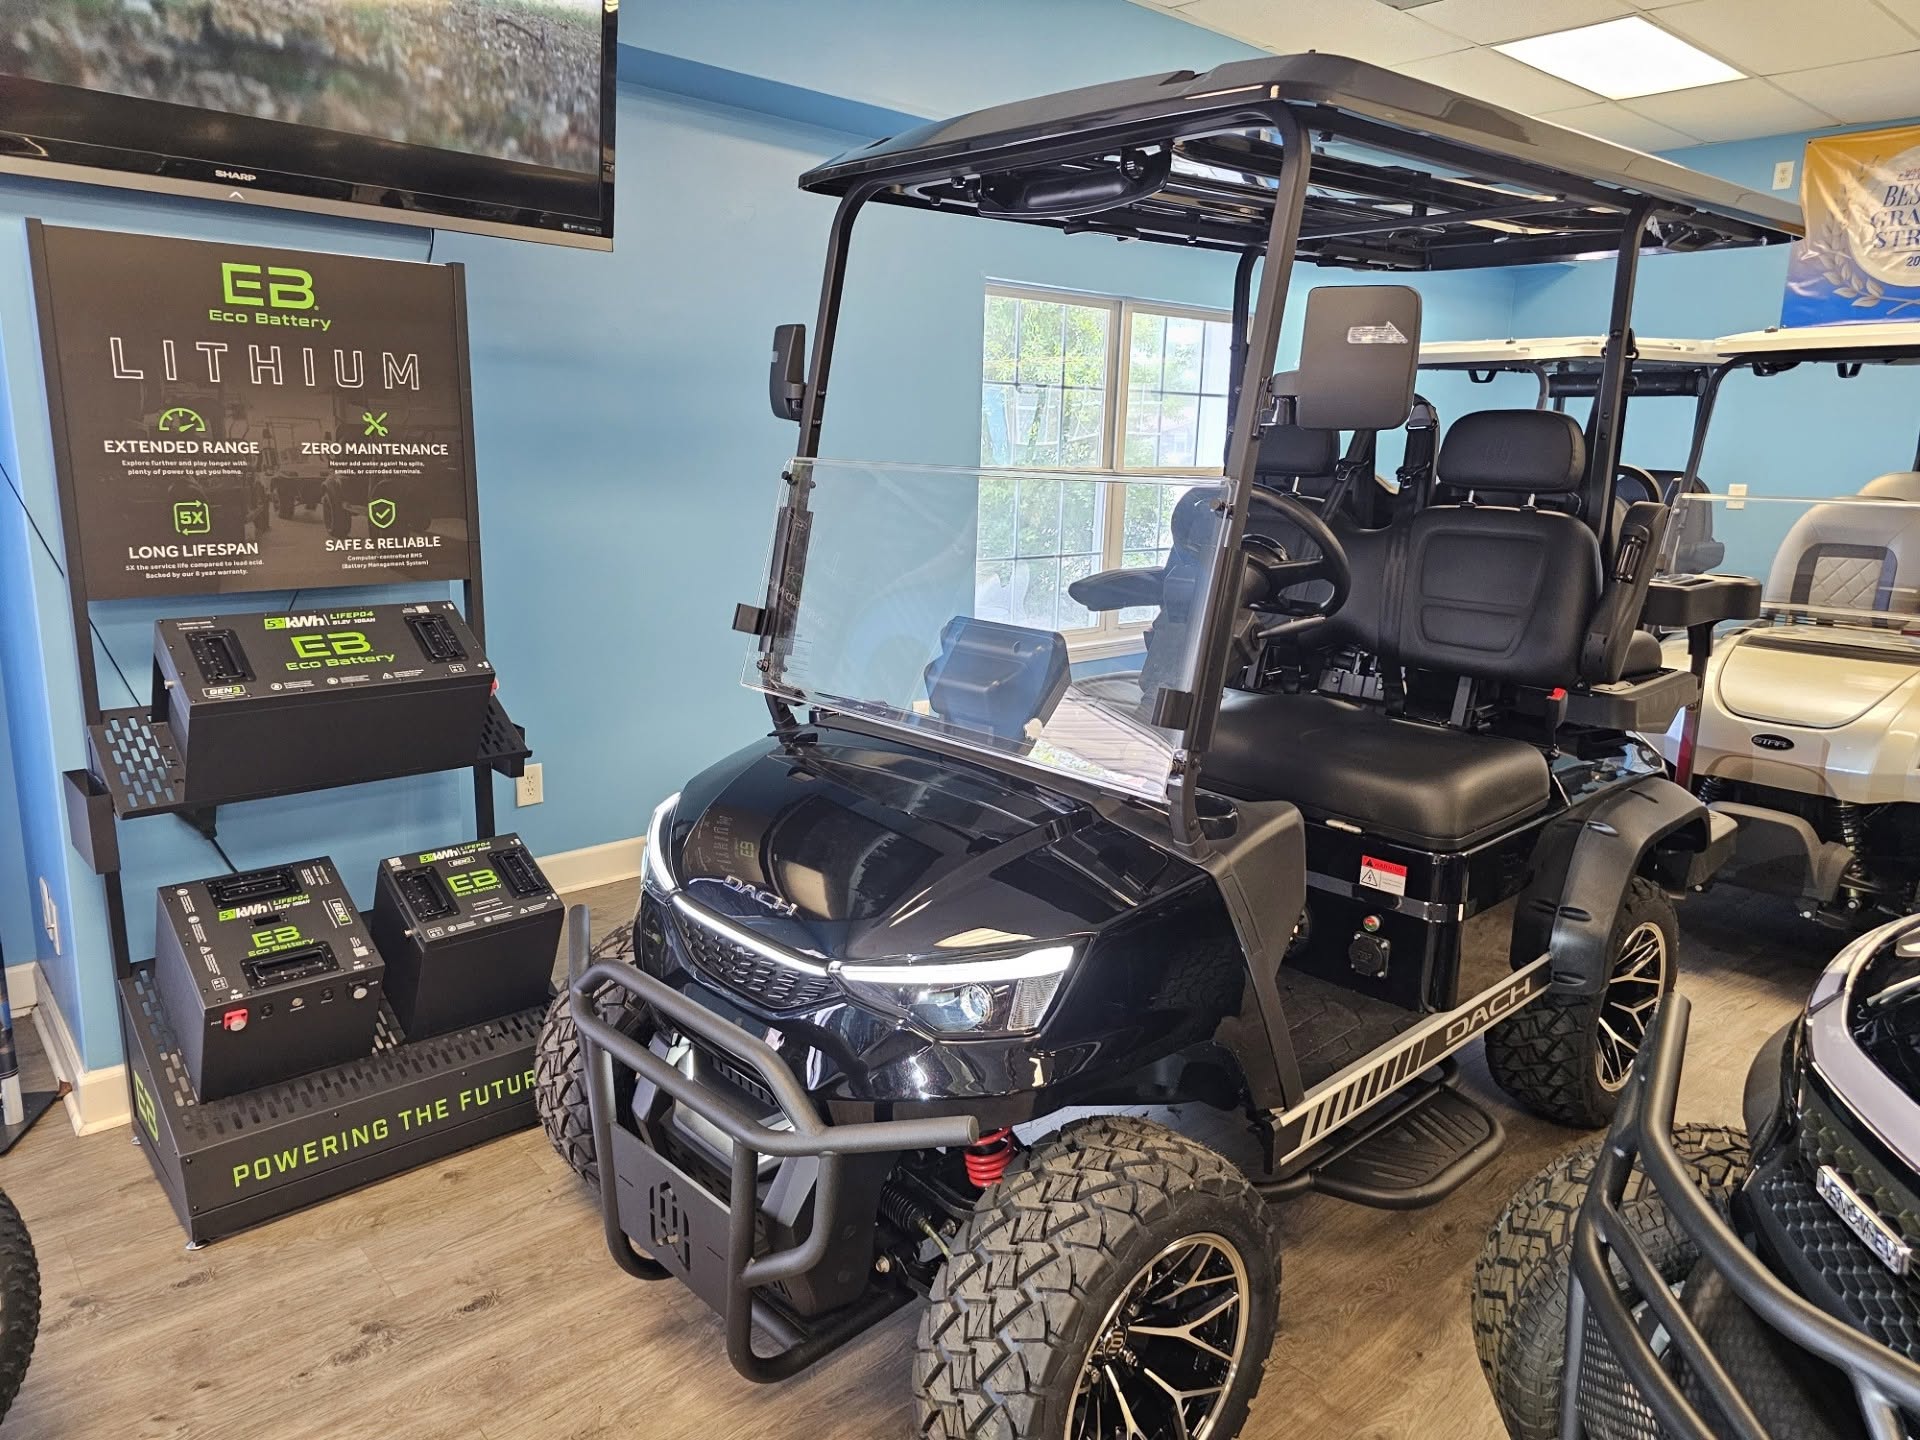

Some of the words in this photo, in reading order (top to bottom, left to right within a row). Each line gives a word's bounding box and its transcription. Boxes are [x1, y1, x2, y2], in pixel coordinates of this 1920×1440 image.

[215, 169, 256, 181] SHARP
[1883, 182, 1920, 207] BES
[1870, 208, 1920, 229] GRA
[1873, 229, 1920, 248] STR
[1906, 255, 1920, 267] 20
[222, 262, 315, 310] EB
[208, 309, 248, 323] Eco
[255, 312, 331, 332] Battery
[109, 337, 420, 390] LITHIUM
[103, 440, 199, 454] EXTENDED
[202, 441, 260, 454] RANGE
[301, 442, 342, 455] ZERO
[345, 443, 449, 456] MAINTENANCE
[179, 511, 204, 525] 5X
[128, 545, 179, 559] LONG
[182, 542, 259, 557] LIFESPAN
[325, 539, 362, 552] SAFE
[364, 538, 375, 550] &
[377, 536, 441, 549] RELIABLE
[150, 563, 176, 571] service
[190, 560, 224, 569] compared
[347, 553, 409, 561] Computer-controlled
[367, 560, 405, 568] Management
[145, 571, 171, 579] Backed
[171, 571, 181, 579] by
[201, 570, 216, 578] year
[291, 631, 371, 658] EB
[285, 661, 321, 671] Eco
[325, 654, 395, 667] Battery
[209, 686, 241, 695] GEN3
[447, 869, 498, 893] EB
[472, 883, 502, 894] Battery
[723, 875, 798, 916] DACH
[251, 925, 300, 948] EB
[271, 938, 314, 951] Battery
[1446, 977, 1531, 1046] DACH
[133, 1069, 159, 1142] EB
[232, 1118, 389, 1188] POWERING
[398, 1097, 449, 1131] THE
[459, 1069, 537, 1112] FUTUR
